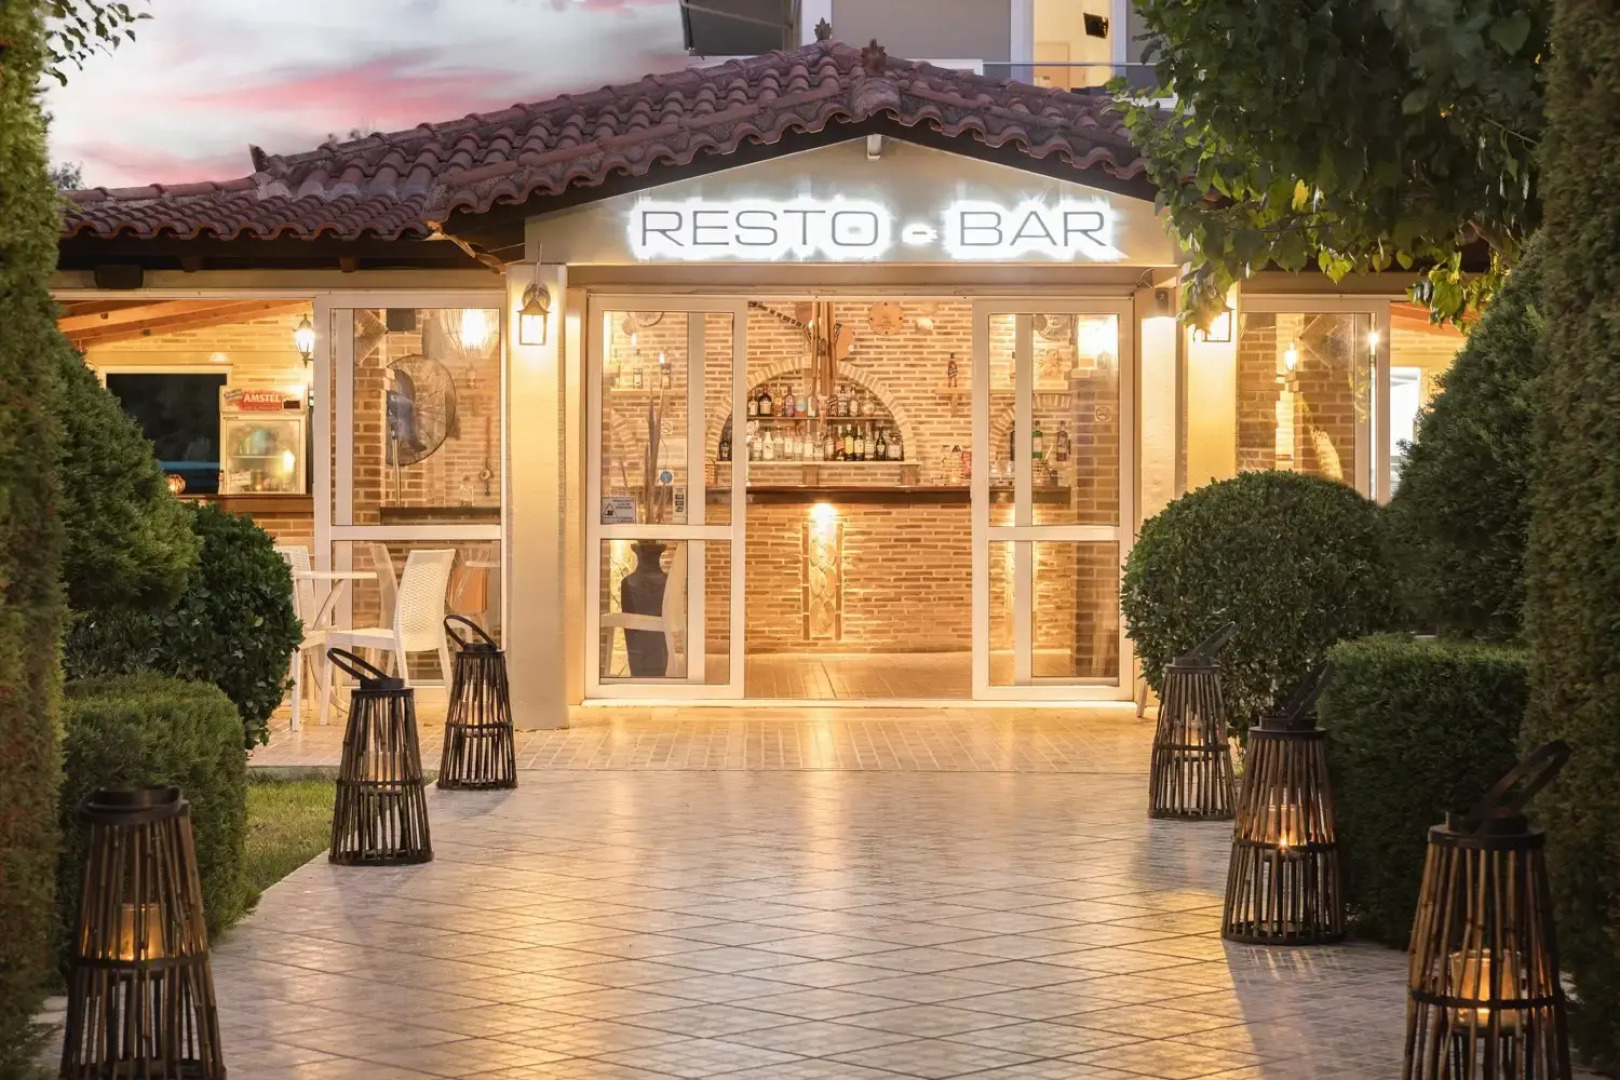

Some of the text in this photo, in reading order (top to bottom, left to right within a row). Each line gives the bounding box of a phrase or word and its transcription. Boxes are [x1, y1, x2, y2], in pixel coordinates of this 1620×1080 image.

[641, 210, 879, 247] RESTO
[959, 210, 1107, 247] BAR
[243, 392, 280, 403] AMSTEL
